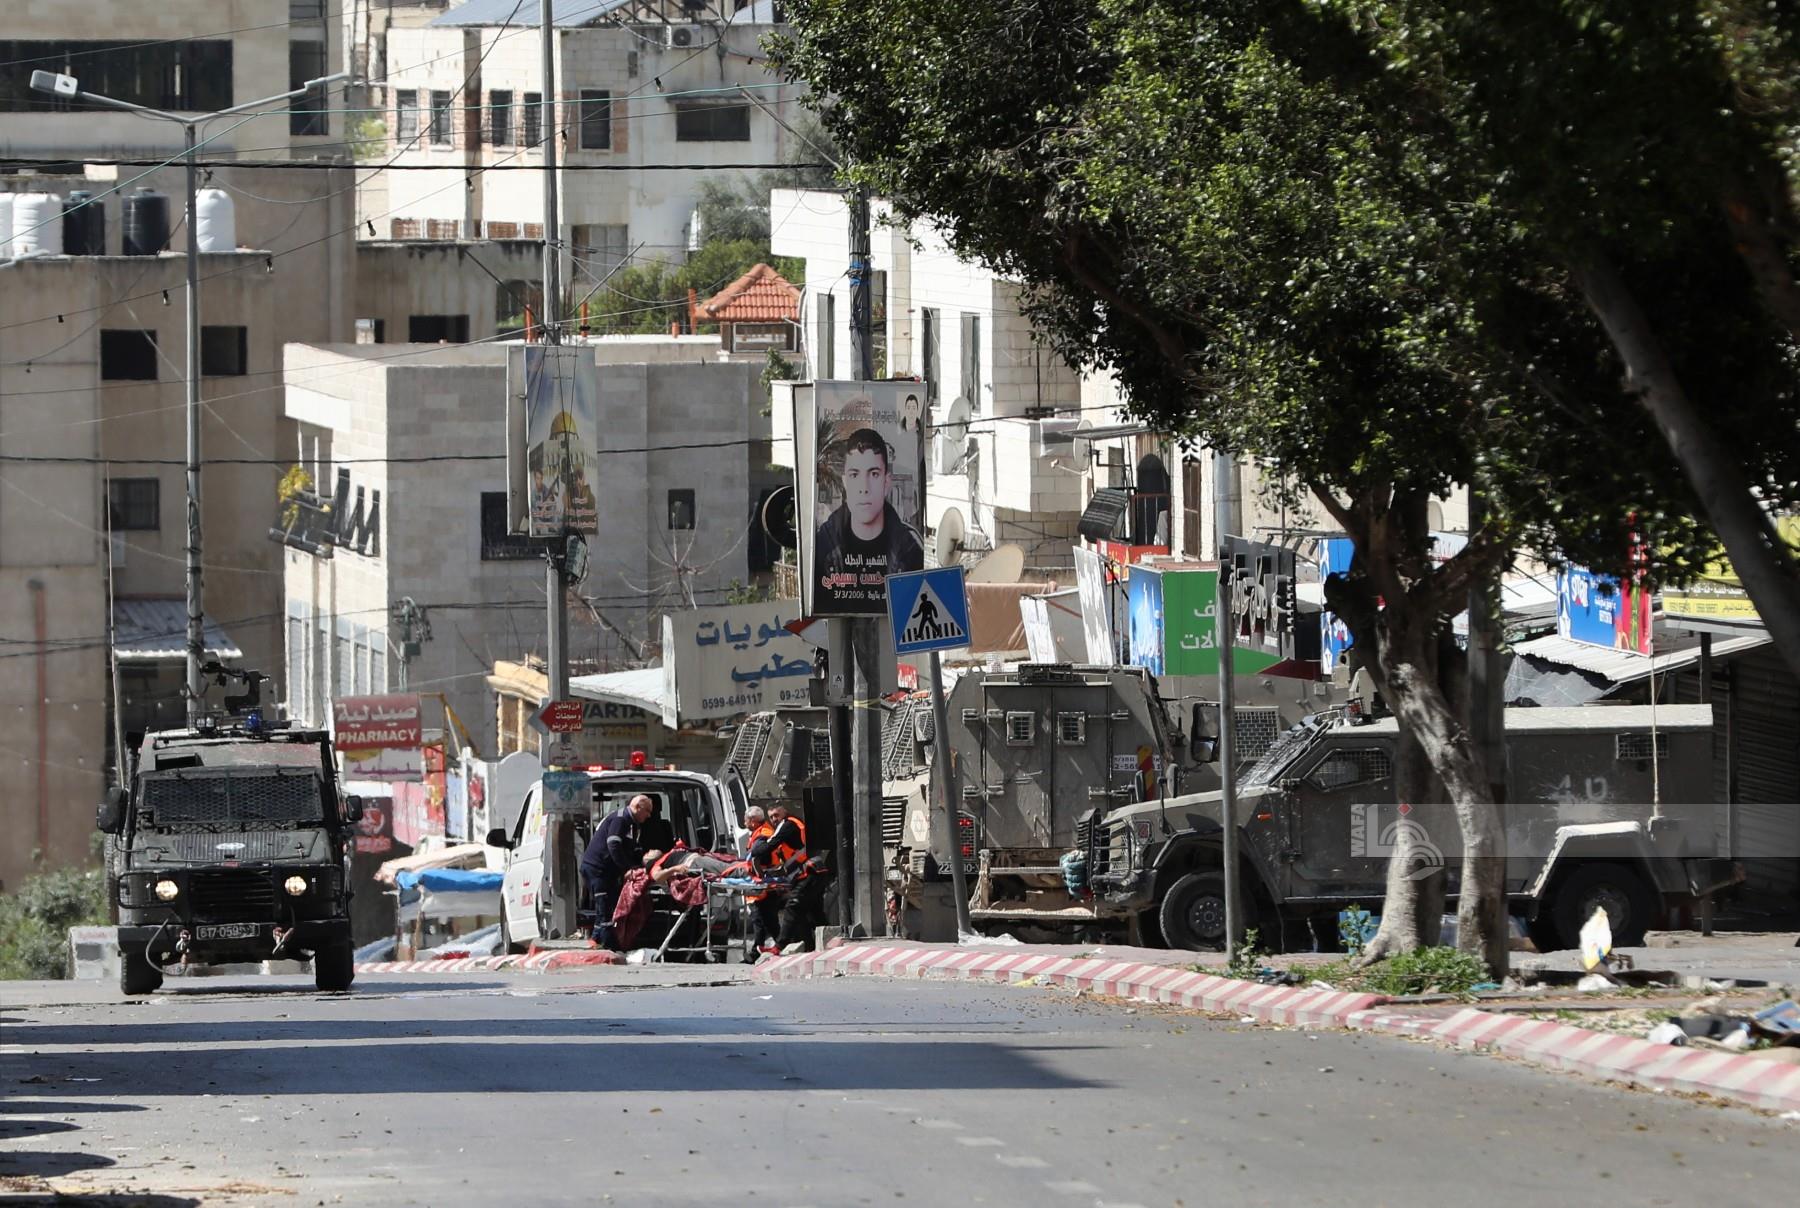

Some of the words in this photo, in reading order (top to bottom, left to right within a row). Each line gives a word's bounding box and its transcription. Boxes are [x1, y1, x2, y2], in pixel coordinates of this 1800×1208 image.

[834, 590, 865, 600] 3/3/2006
[731, 650, 814, 689] طب
[702, 692, 763, 710] 0599-649117
[779, 687, 810, 701] 09-237
[335, 703, 418, 729] صيدلية
[337, 728, 418, 745] PHARMACY
